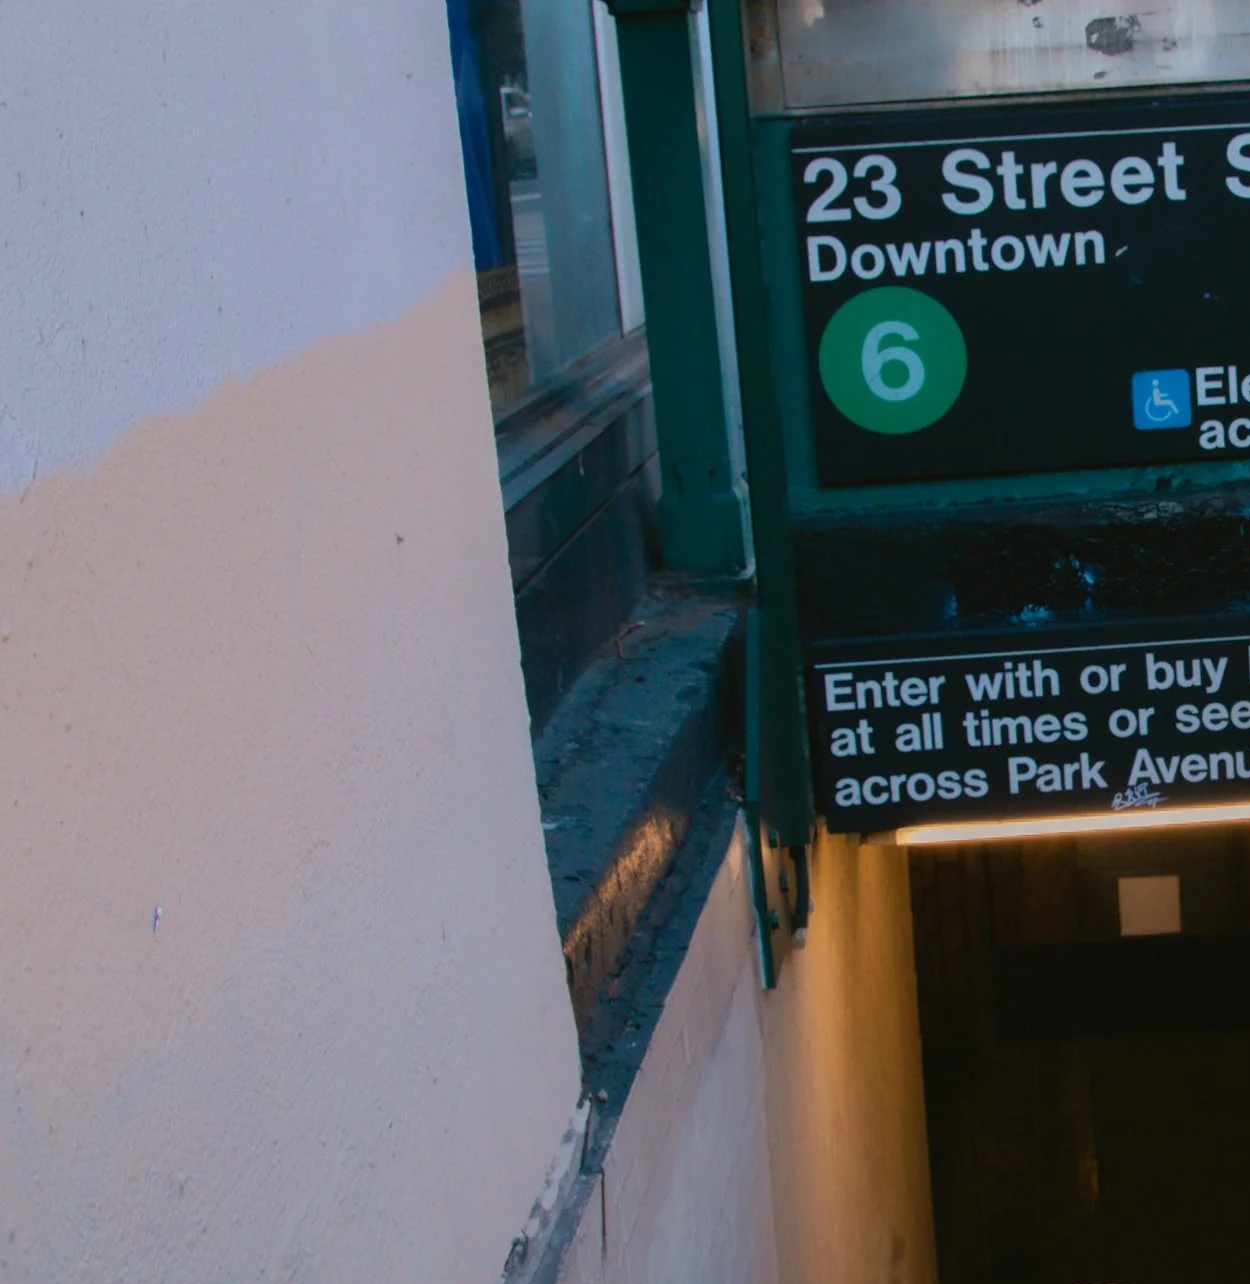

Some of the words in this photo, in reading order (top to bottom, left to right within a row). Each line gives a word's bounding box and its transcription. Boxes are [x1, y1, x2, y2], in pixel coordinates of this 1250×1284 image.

[803, 154, 902, 223] 23
[941, 141, 1187, 215] Street
[806, 229, 1106, 282] Downtown
[860, 319, 926, 403] 6
[824, 671, 946, 712] Enter
[963, 661, 1060, 702] with
[1079, 662, 1127, 695] or
[1145, 652, 1230, 694] buy
[830, 718, 876, 757] at
[895, 710, 944, 753] all
[962, 706, 1089, 747] times
[1108, 706, 1156, 738] or
[835, 768, 989, 807] across
[1007, 753, 1109, 795] Park
